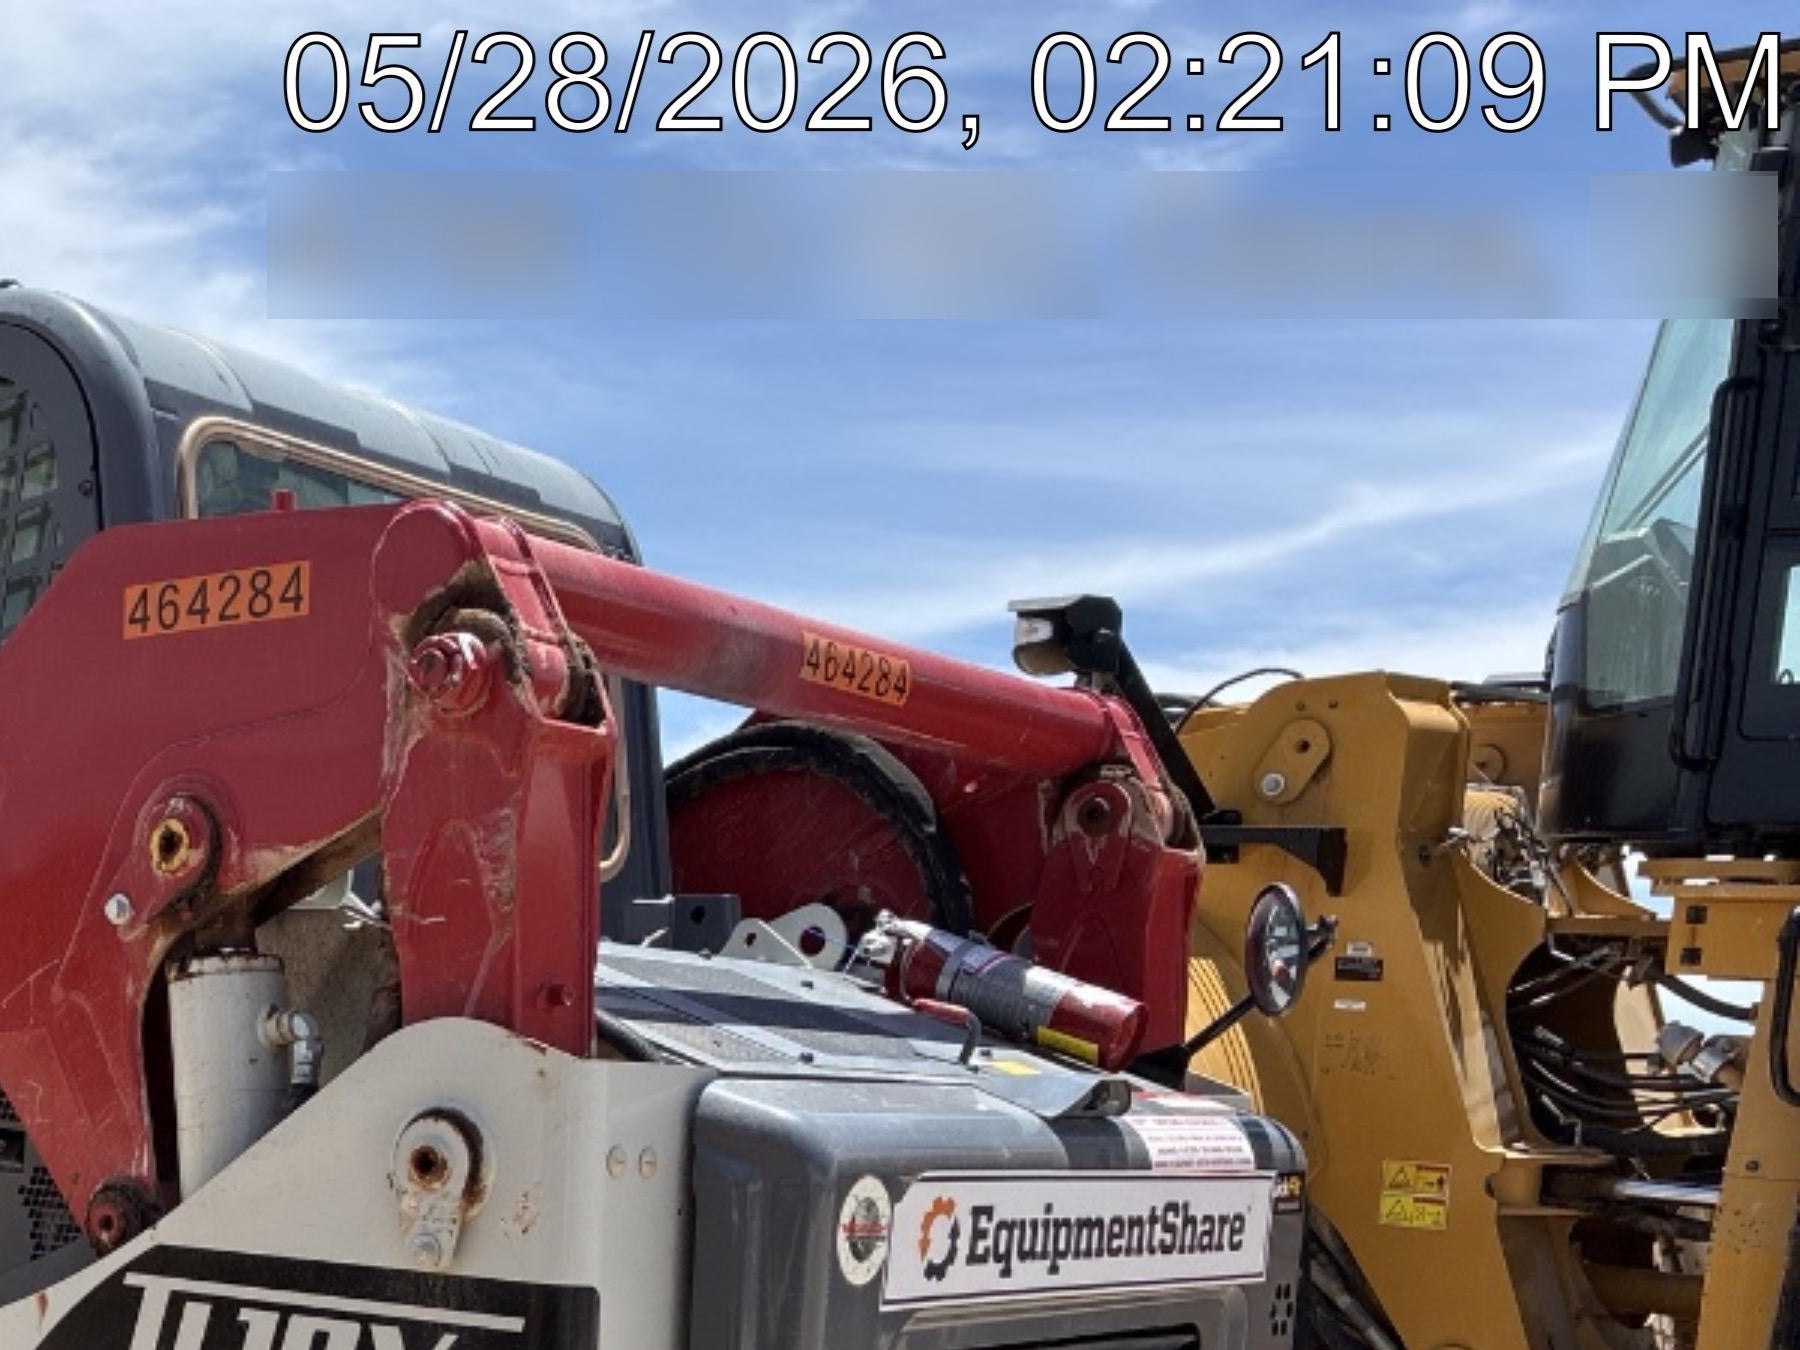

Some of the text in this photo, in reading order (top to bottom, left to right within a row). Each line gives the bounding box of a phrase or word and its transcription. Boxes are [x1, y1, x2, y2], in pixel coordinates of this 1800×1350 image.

[128, 565, 304, 634] 464284
[806, 639, 907, 702] 464284
[964, 1200, 1246, 1279] EquipmentShare
